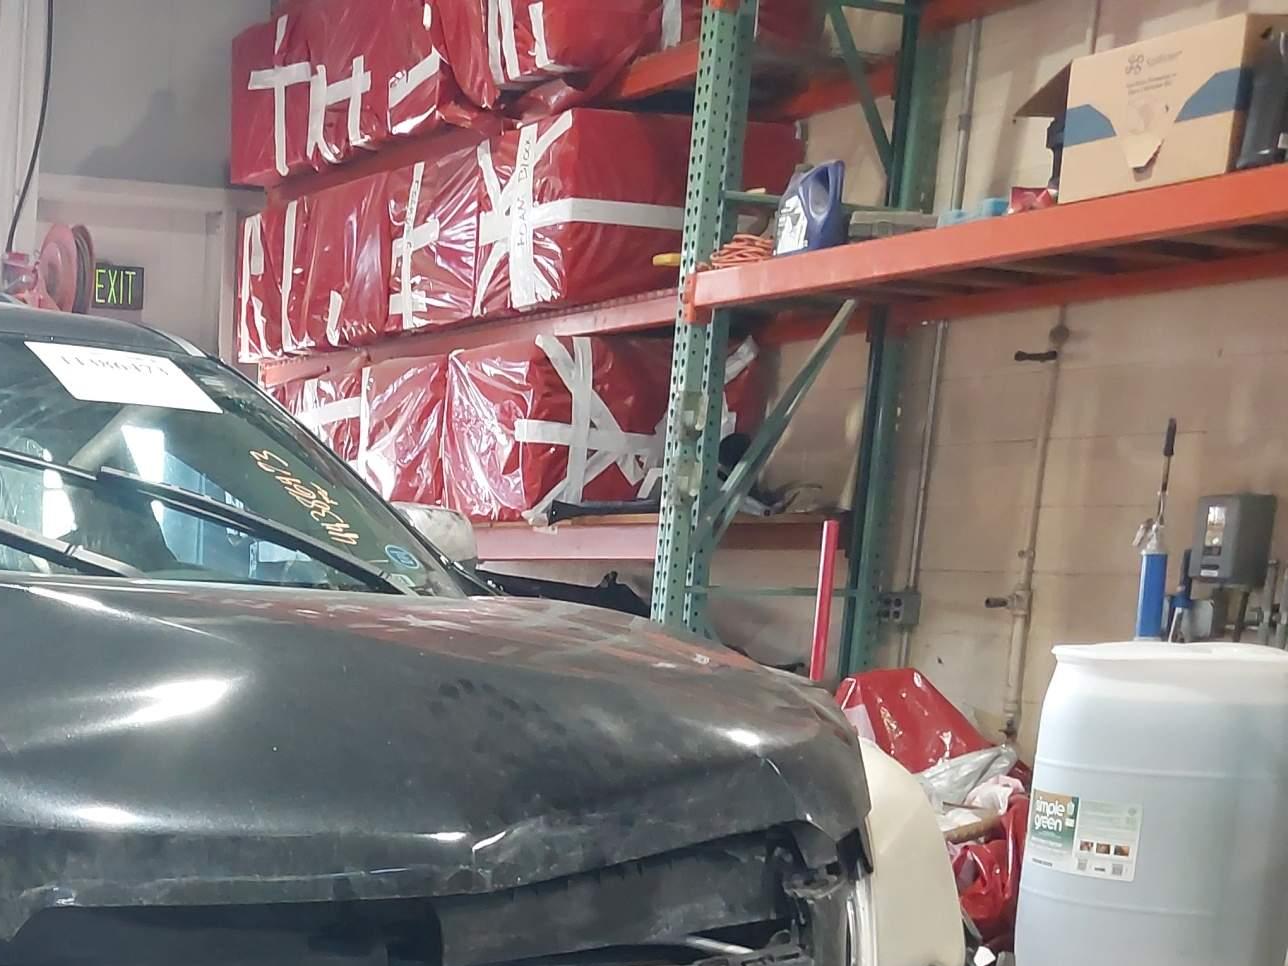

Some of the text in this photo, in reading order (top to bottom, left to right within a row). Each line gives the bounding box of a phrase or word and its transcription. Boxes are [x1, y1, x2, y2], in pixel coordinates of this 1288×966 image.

[95, 268, 137, 305] EXIT
[1035, 796, 1066, 817] simple
[1034, 813, 1063, 832] green
